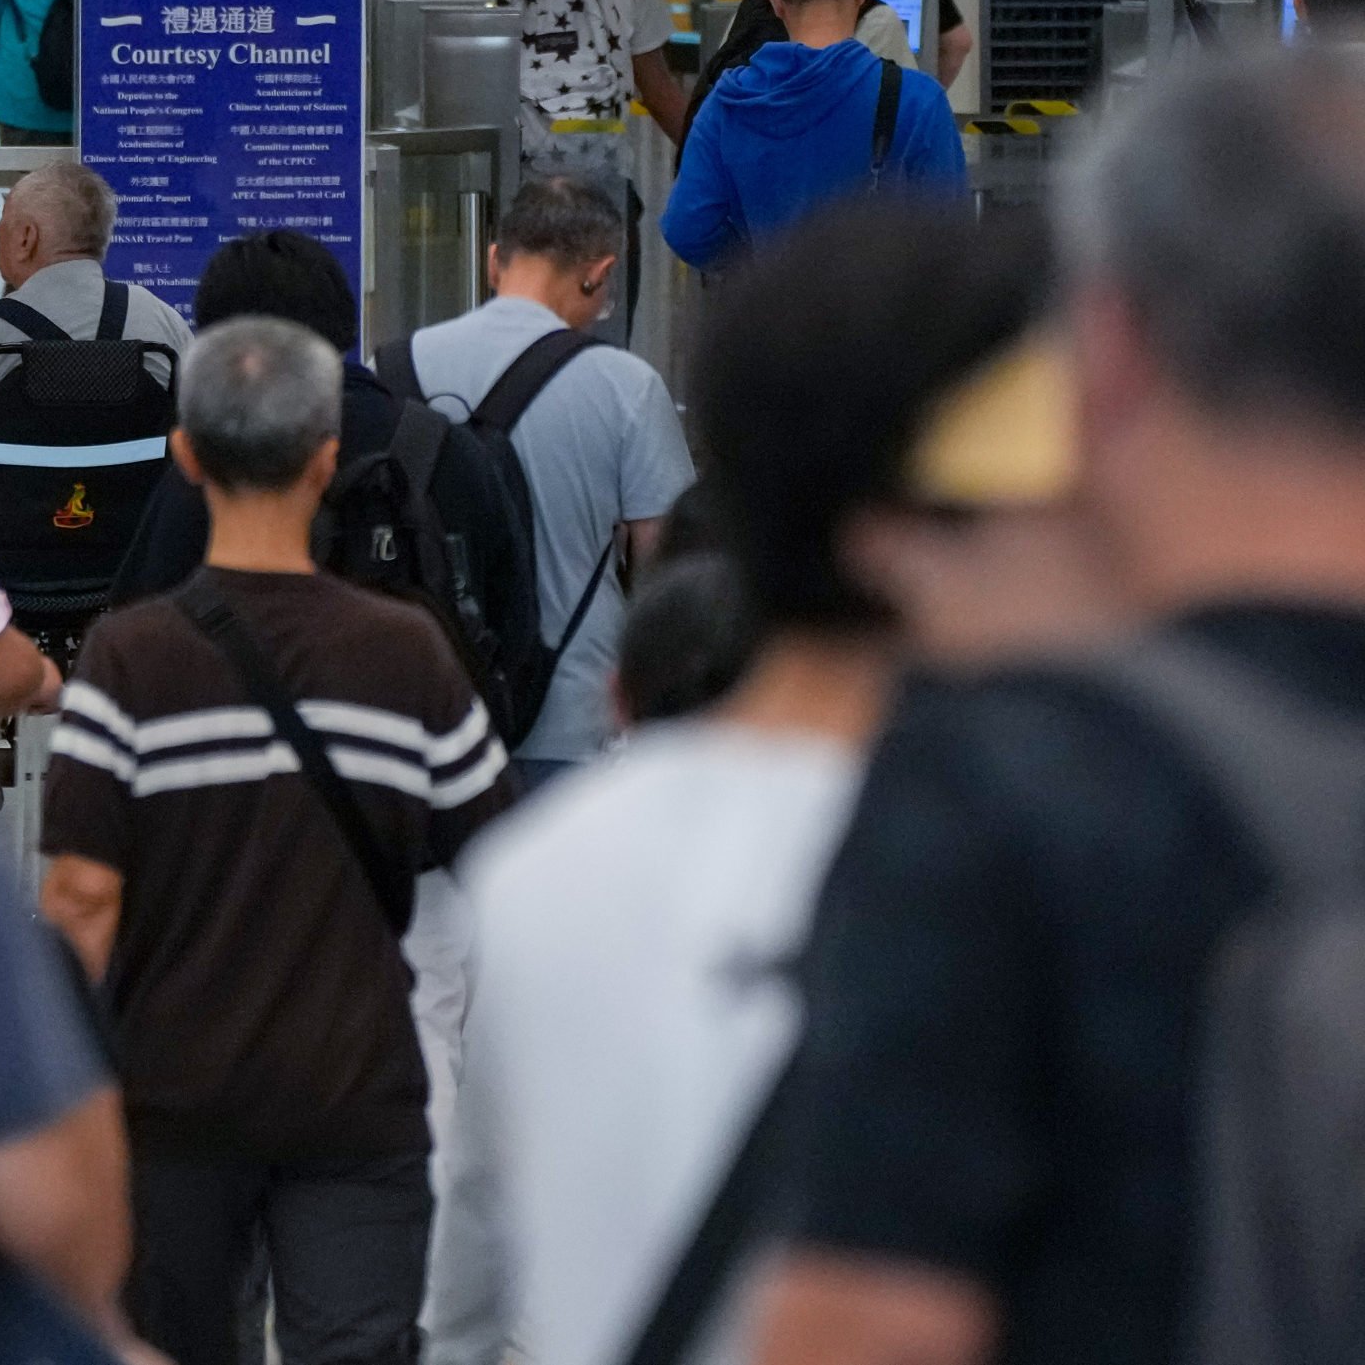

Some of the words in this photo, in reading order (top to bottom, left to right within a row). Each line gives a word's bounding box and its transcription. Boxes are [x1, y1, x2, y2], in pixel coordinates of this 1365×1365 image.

[160, 6, 276, 35] 禮遇通道
[111, 43, 222, 70] Courtesy
[228, 43, 331, 65] Channel
